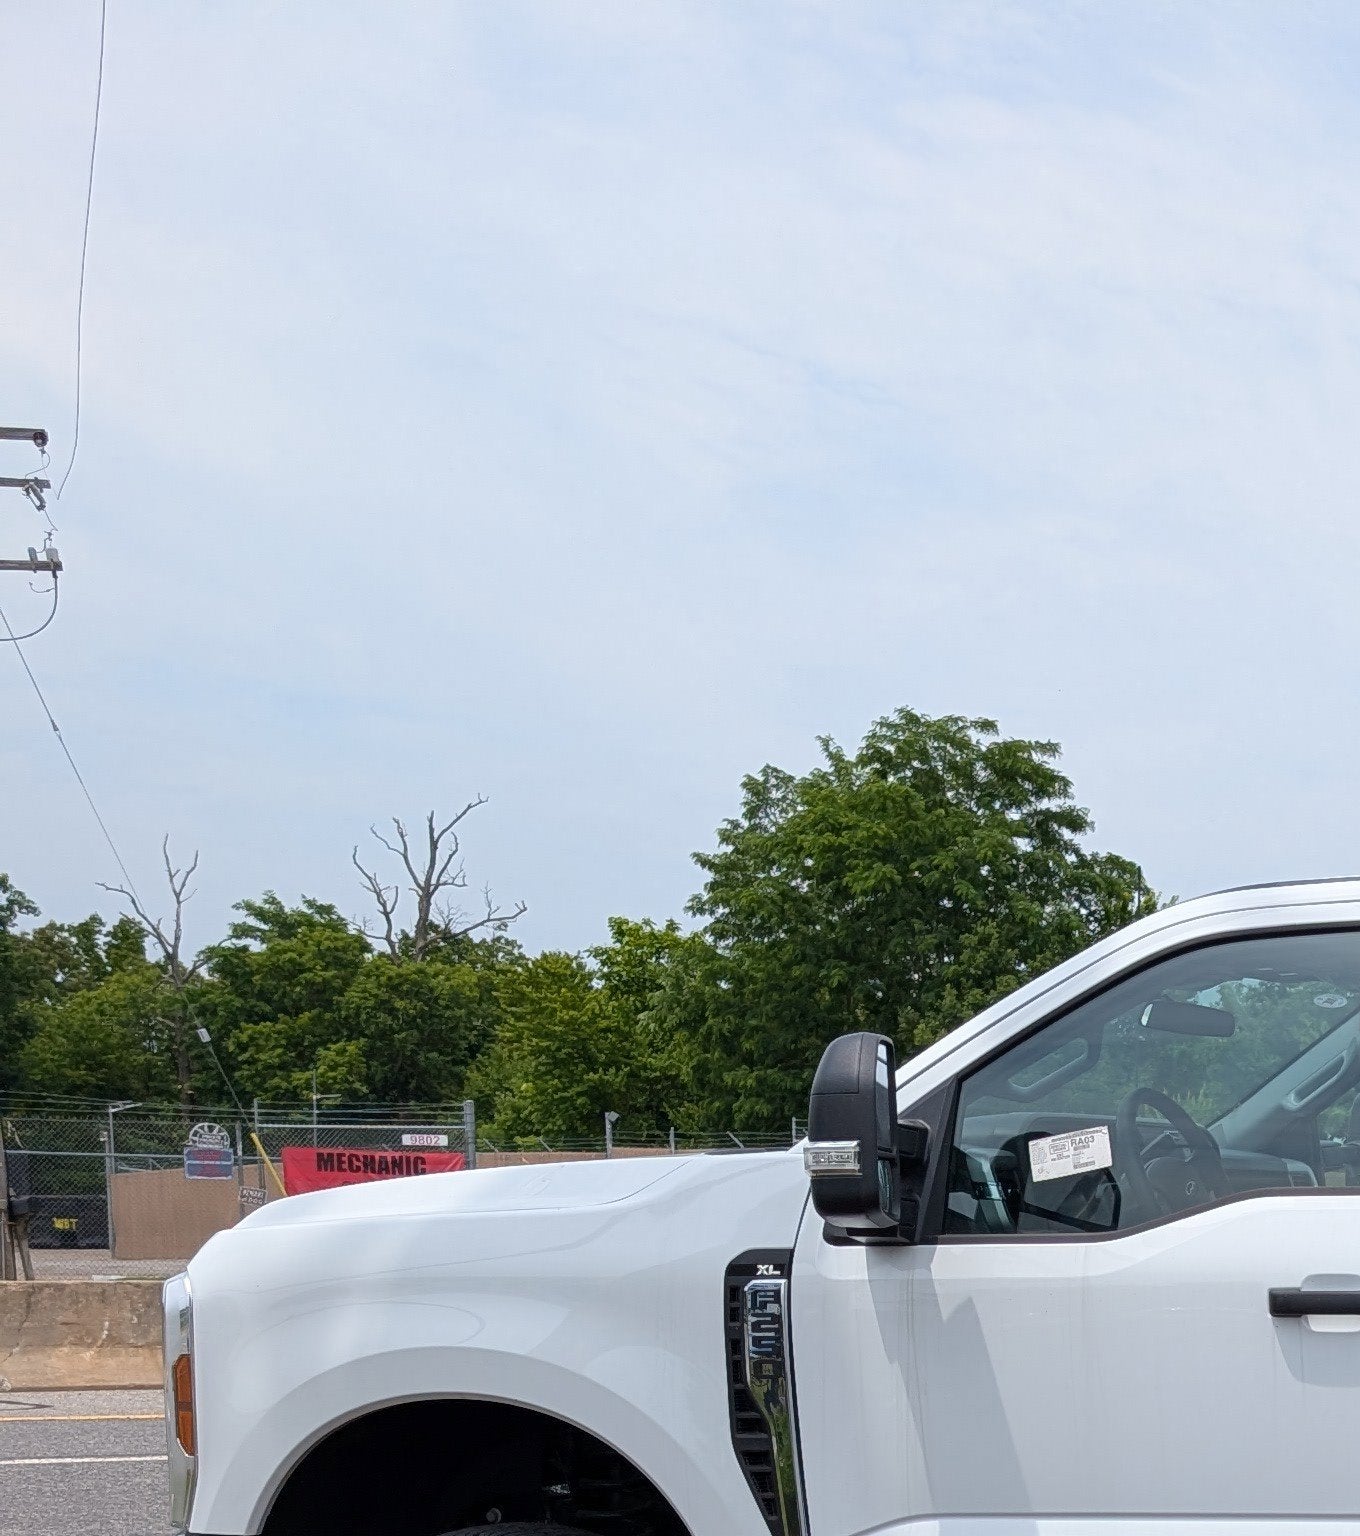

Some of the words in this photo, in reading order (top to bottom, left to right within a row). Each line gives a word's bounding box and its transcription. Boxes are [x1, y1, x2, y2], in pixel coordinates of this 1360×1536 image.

[410, 1135, 441, 1145] 9802
[1070, 1135, 1095, 1147] RA03
[316, 1152, 427, 1175] MECHANIC
[756, 1264, 781, 1276] XL
